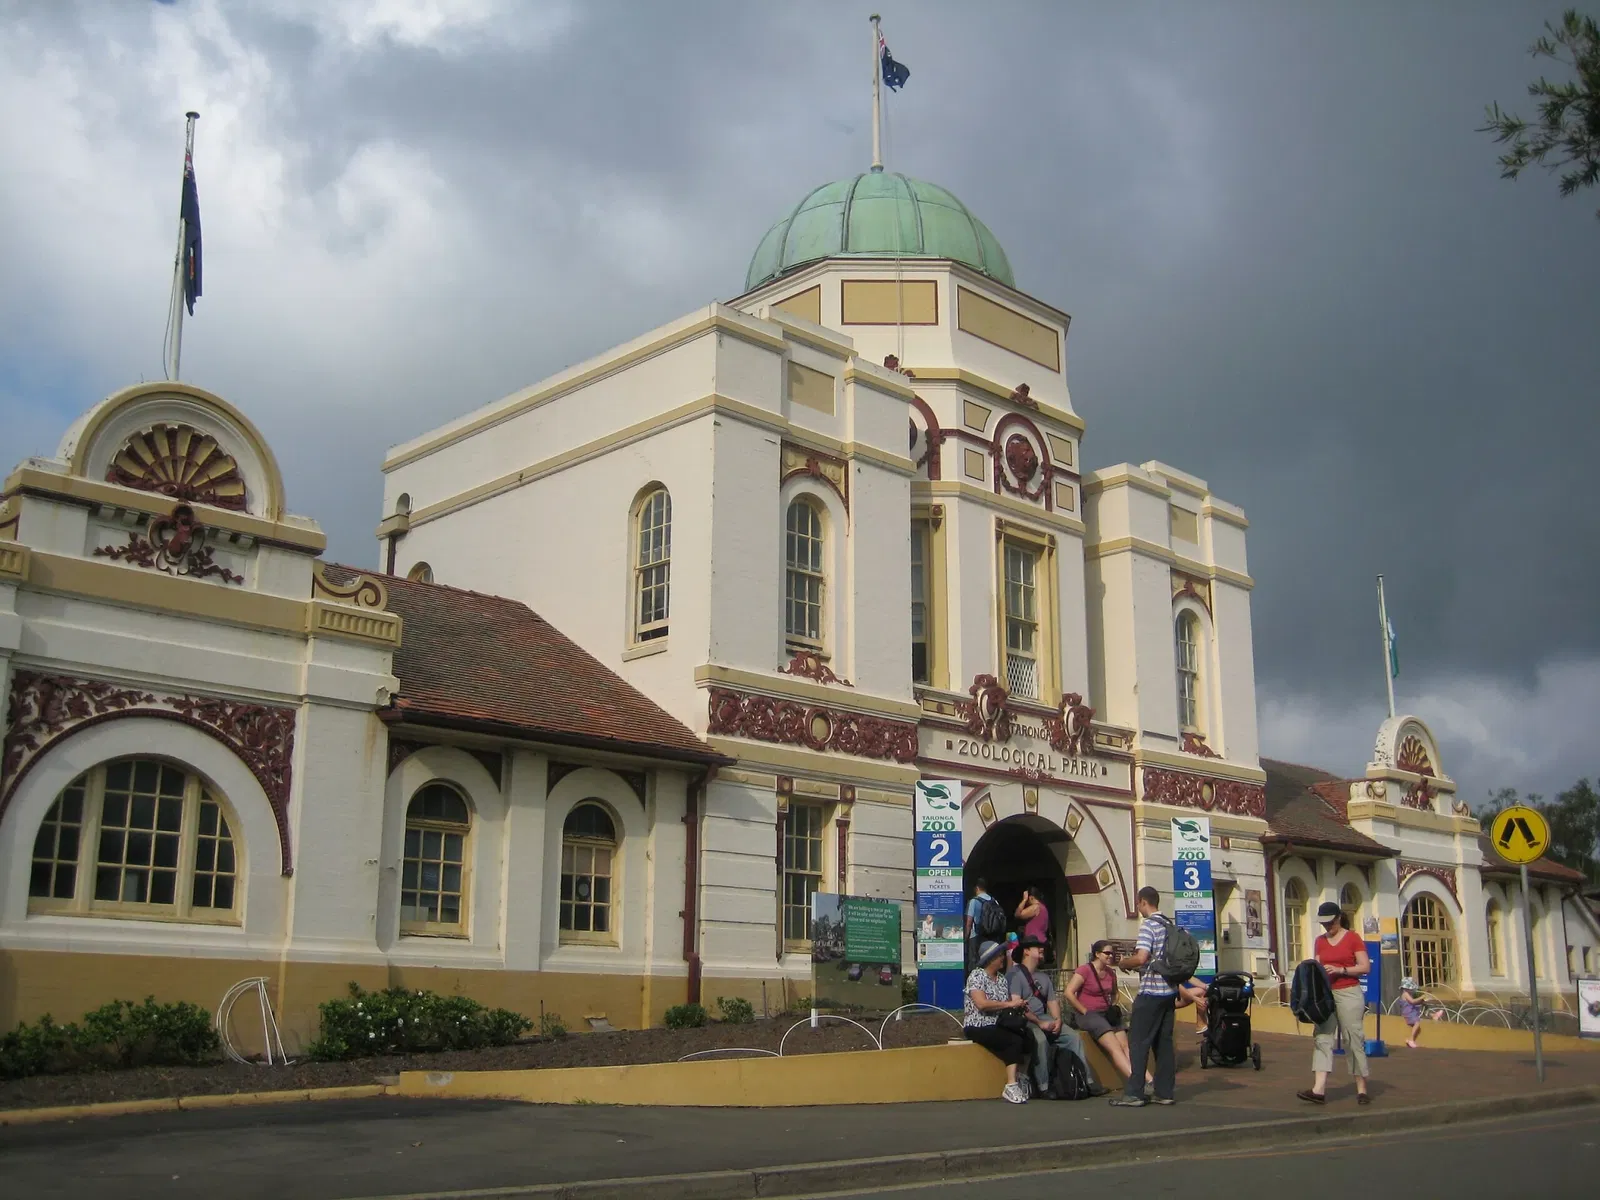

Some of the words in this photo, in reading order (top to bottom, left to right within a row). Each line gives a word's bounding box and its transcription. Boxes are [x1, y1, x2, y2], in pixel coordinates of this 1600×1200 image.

[1009, 722, 1052, 741] TARONGA
[957, 739, 1057, 771] ZOOLOGICAL
[1061, 756, 1098, 778] PARK
[922, 820, 955, 831] ZOO
[930, 839, 950, 867] 2
[1178, 851, 1205, 860] ZOO
[1184, 867, 1200, 890] 3
